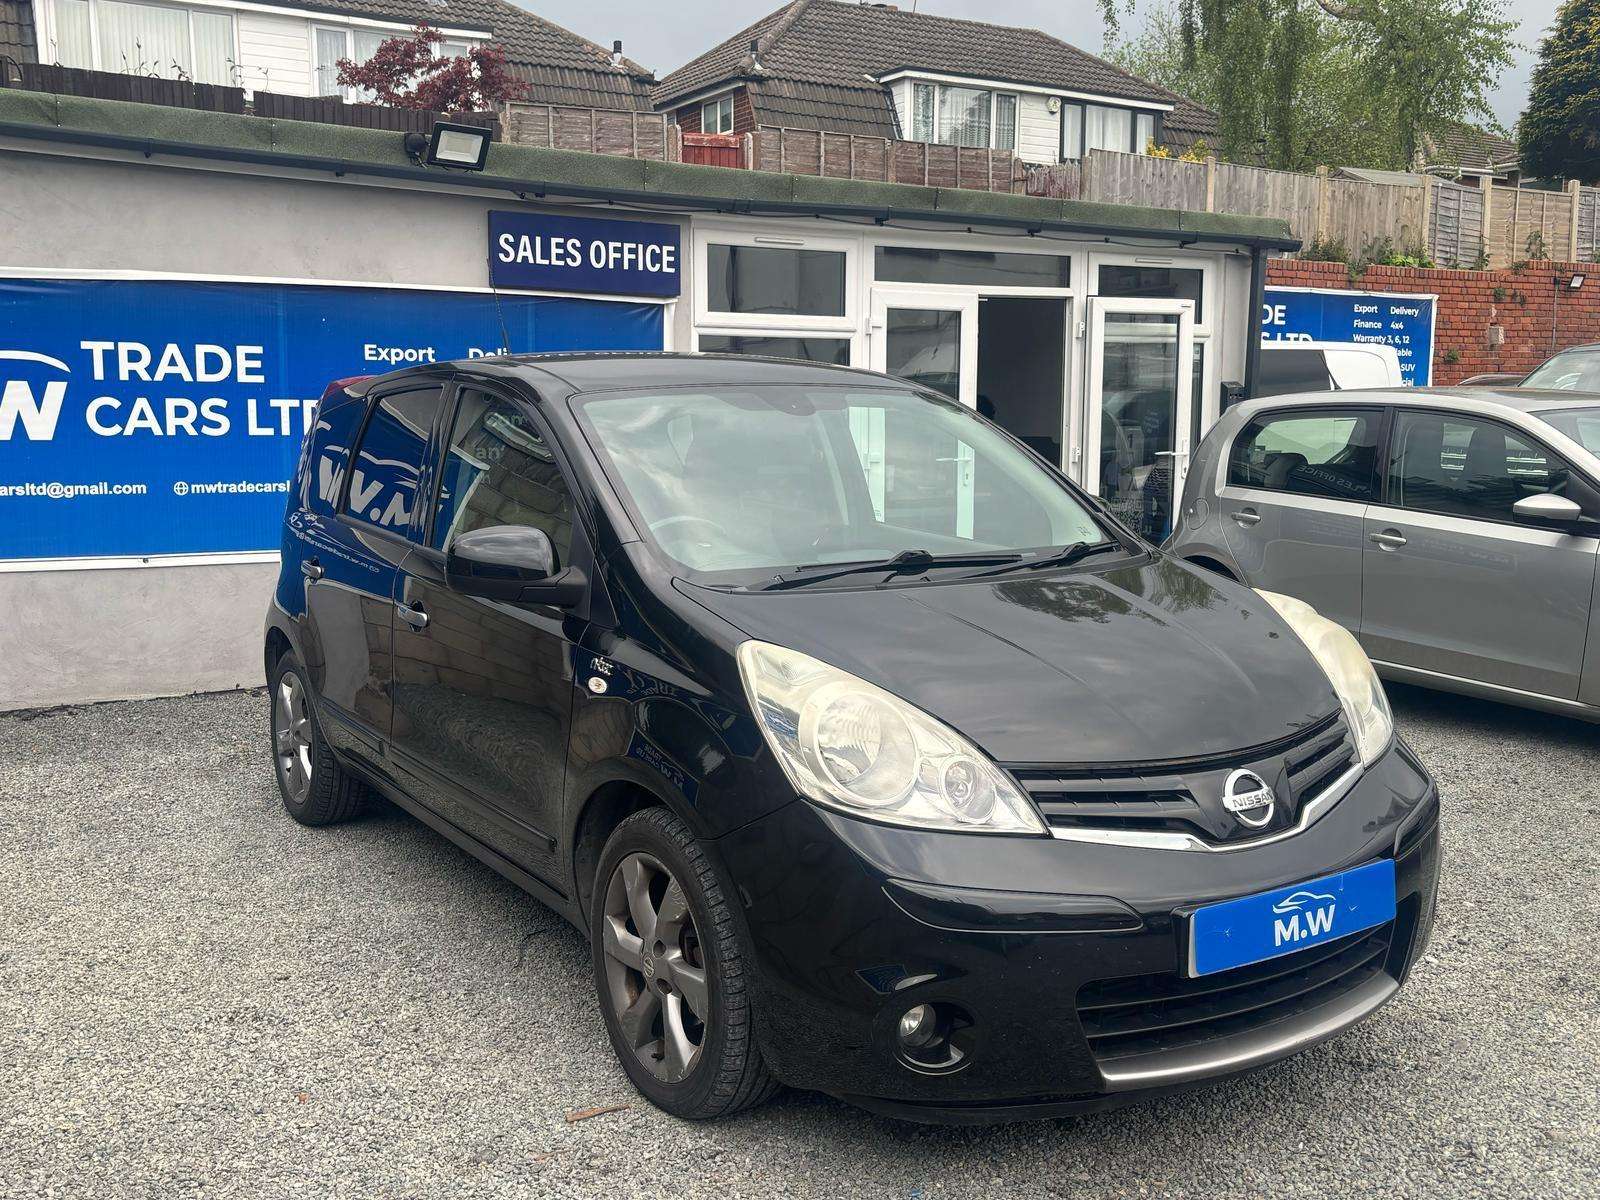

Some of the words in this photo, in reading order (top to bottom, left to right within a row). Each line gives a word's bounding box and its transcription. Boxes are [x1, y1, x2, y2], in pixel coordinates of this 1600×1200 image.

[497, 233, 583, 268] SALES
[589, 240, 677, 273] OFFICE
[1353, 304, 1379, 315] Export
[1390, 306, 1419, 318] Delivery
[1353, 319, 1383, 329] Finance
[1390, 322, 1404, 330] 4x4
[1352, 333, 1387, 345] Warranty
[1394, 335, 1402, 346] 6,
[1402, 335, 1410, 344] 12
[80, 340, 265, 384] TRADE
[364, 344, 436, 365] Export
[1400, 364, 1416, 372] SUV
[85, 396, 231, 437] CARS
[1232, 793, 1273, 808] NISSAN
[1274, 905, 1336, 947] M.W
